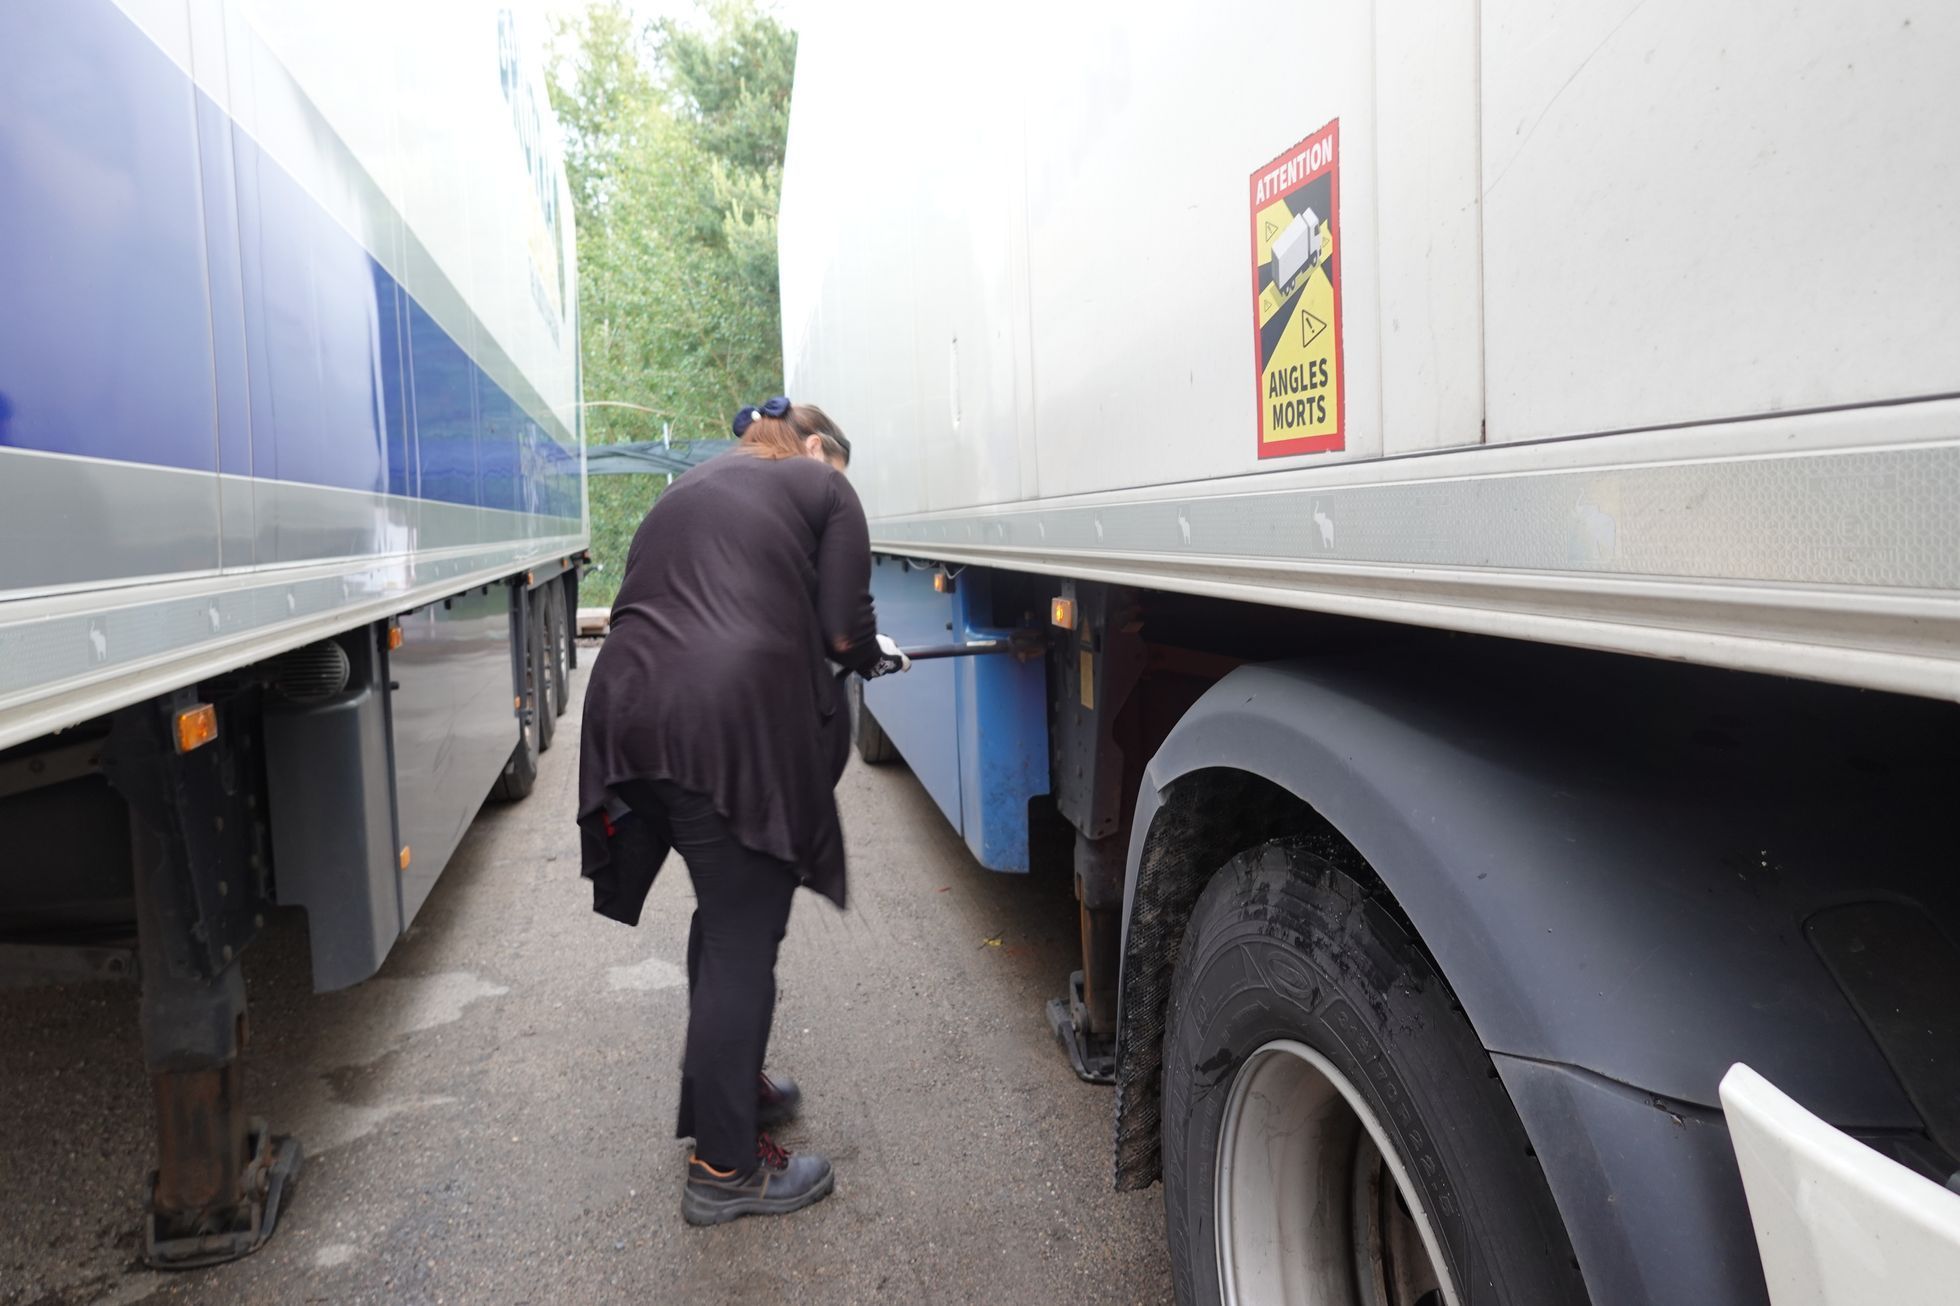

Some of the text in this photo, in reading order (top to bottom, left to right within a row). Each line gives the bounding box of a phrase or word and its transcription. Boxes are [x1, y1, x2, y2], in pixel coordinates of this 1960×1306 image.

[1255, 134, 1333, 206] ATTENTION
[1268, 357, 1328, 400] ANGLES
[1272, 394, 1326, 431] MORTS
